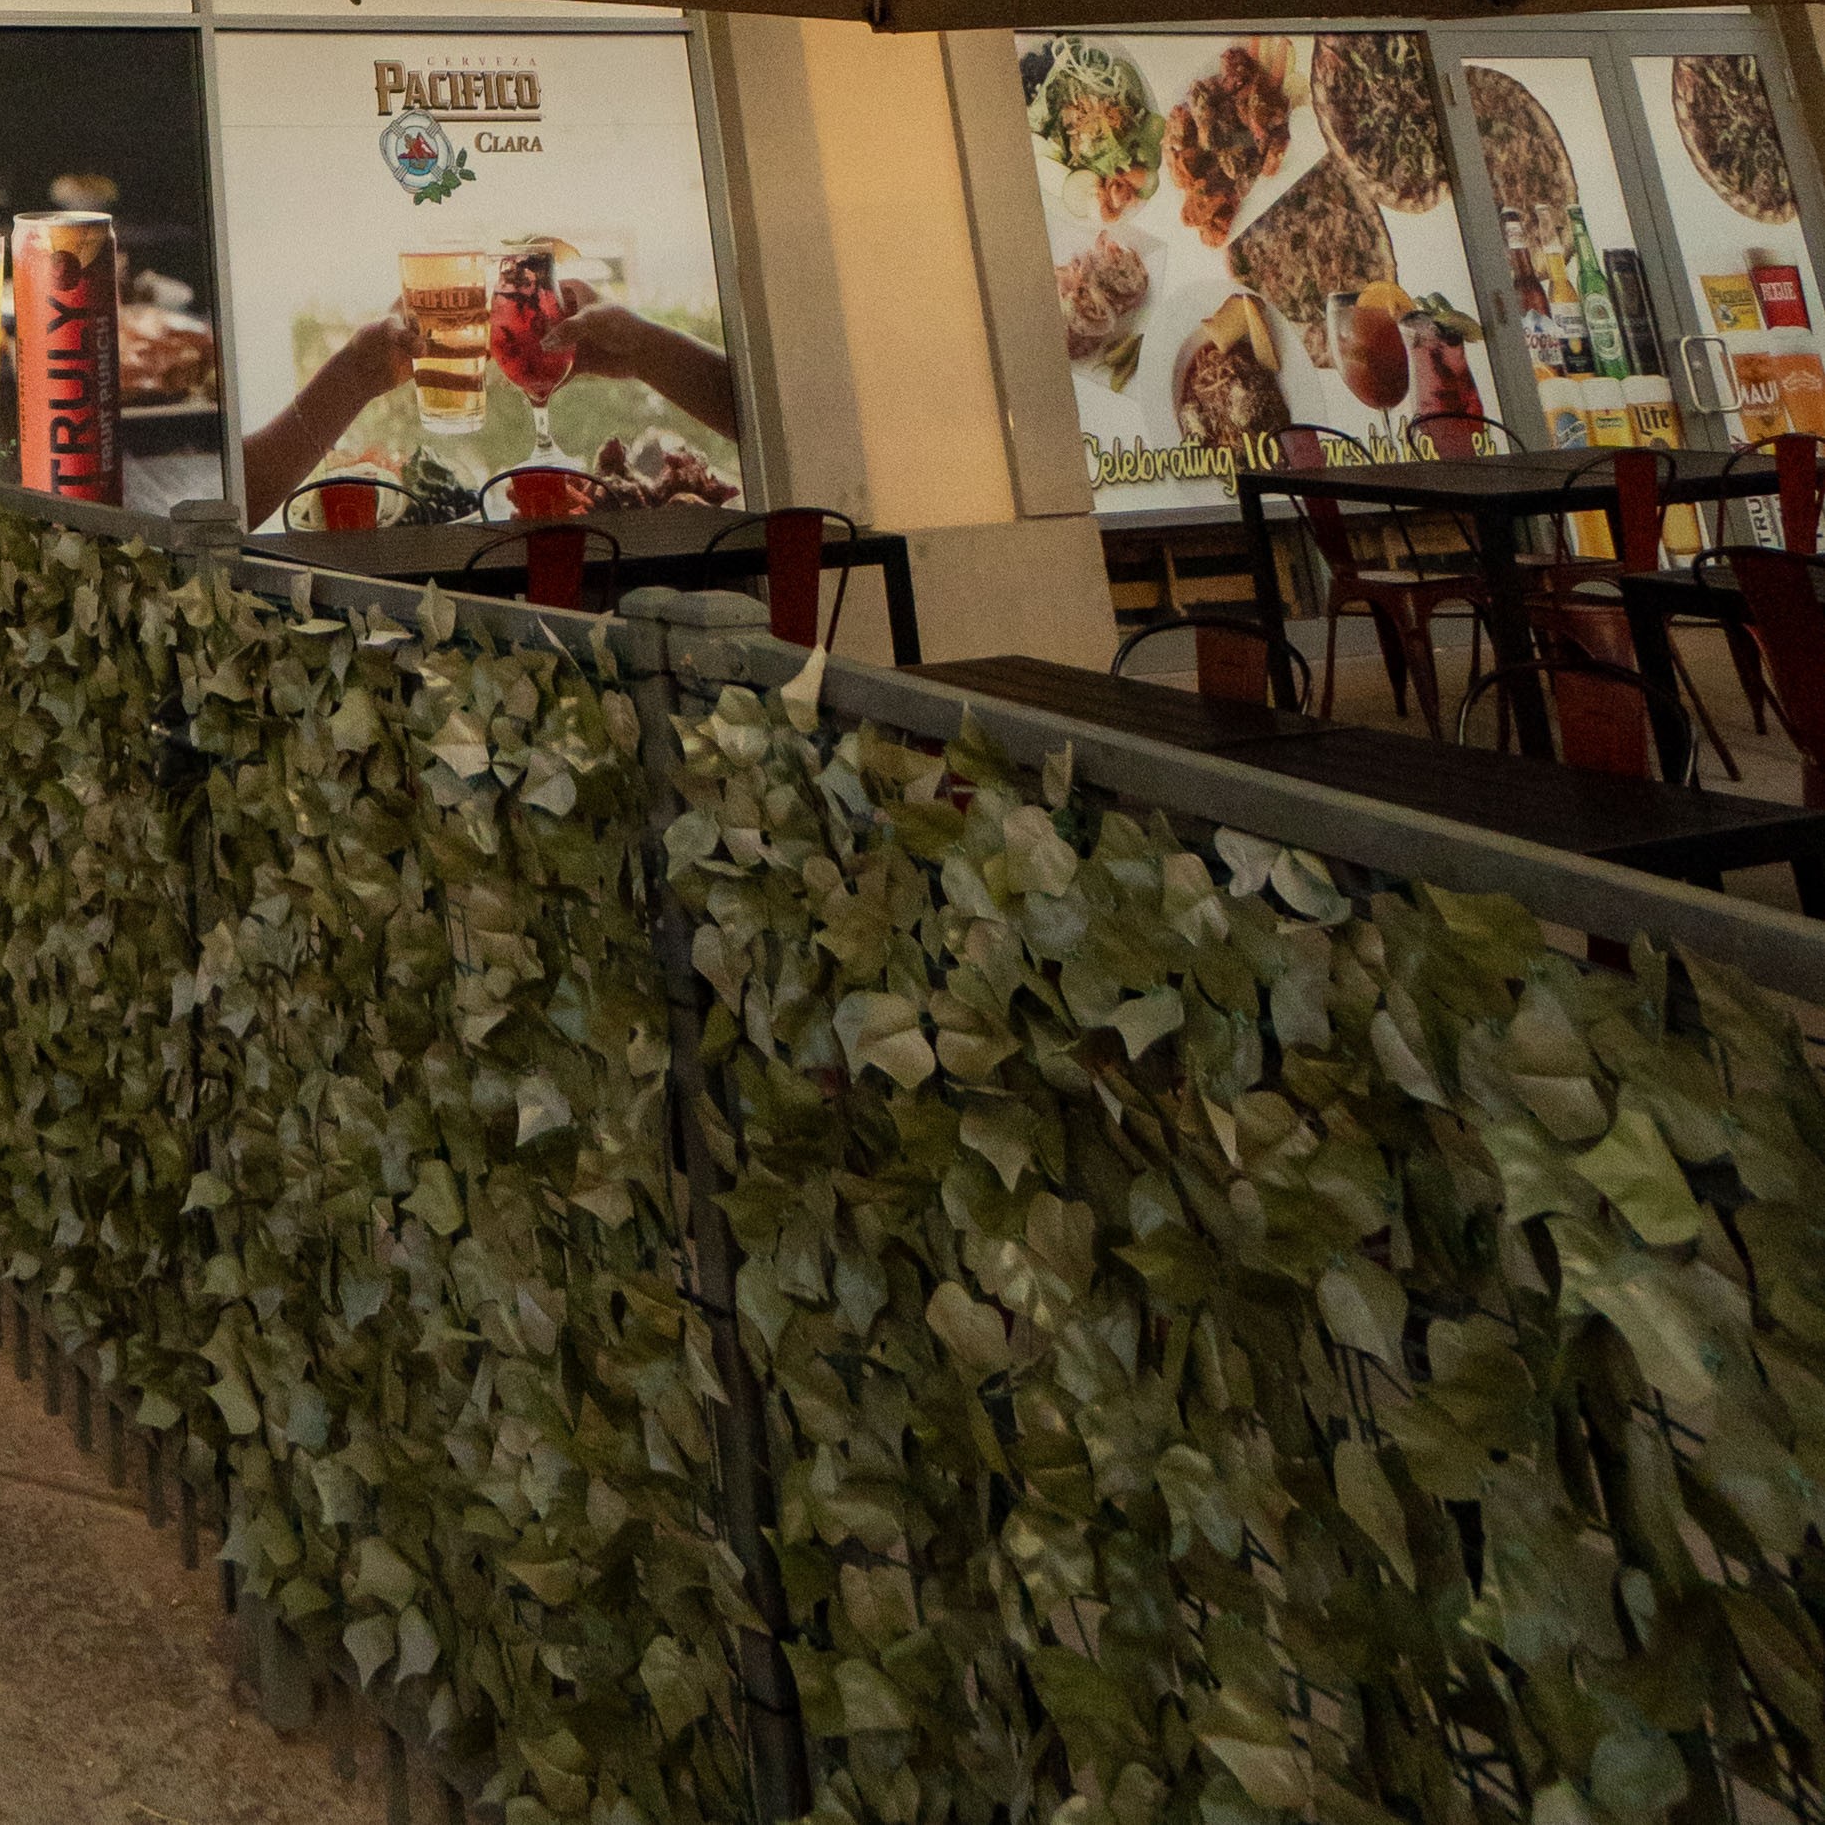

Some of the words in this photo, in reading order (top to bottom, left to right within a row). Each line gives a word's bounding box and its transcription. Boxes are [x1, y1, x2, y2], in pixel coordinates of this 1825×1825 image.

[427, 56, 537, 66] CERVEZA
[374, 59, 542, 116] PACIFICO
[474, 131, 544, 153] CLARA
[46, 294, 98, 495] TRULY
[1634, 405, 1670, 437] Lite
[1748, 498, 1772, 546] TRU
